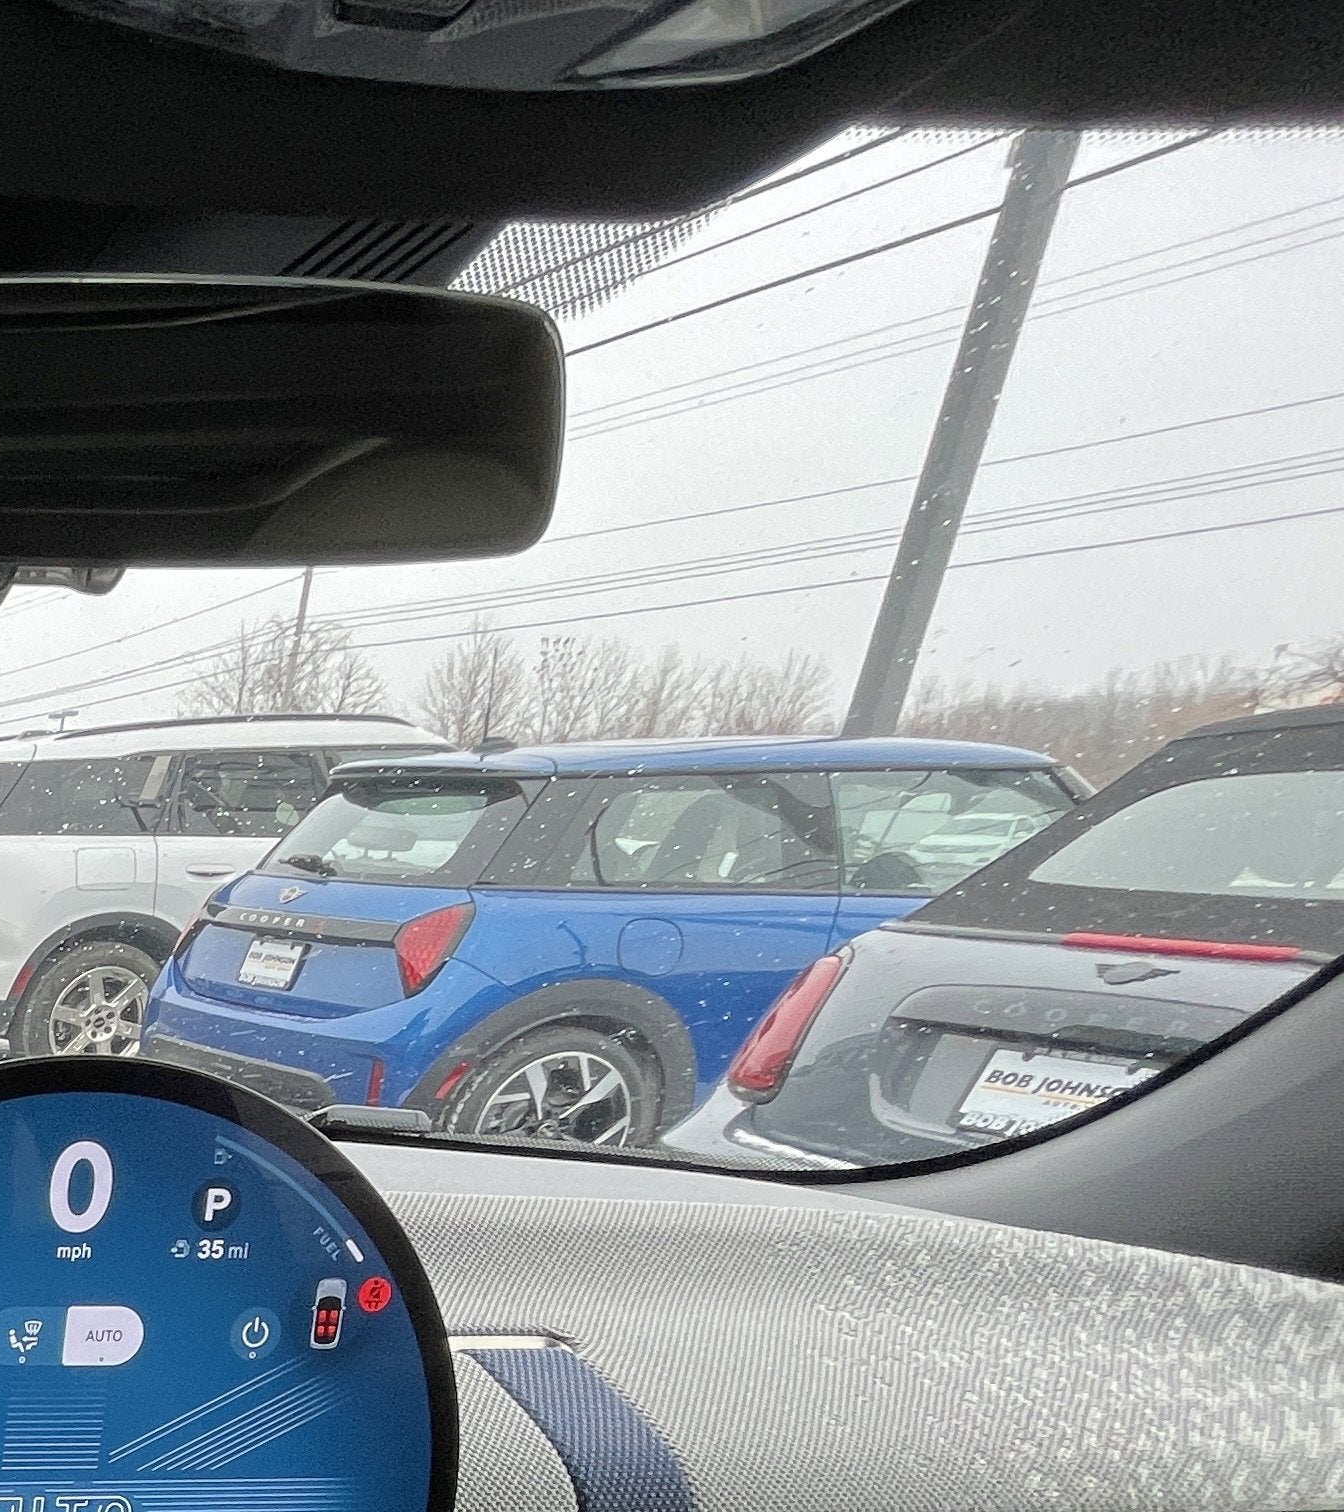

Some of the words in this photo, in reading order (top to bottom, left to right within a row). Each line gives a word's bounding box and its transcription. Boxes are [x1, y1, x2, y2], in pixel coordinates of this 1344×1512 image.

[238, 912, 306, 928] COOPER
[984, 1069, 1034, 1089] BOB
[1032, 1076, 1130, 1099] JOHNSO
[49, 1140, 113, 1234] 0
[204, 1187, 233, 1222] P
[56, 1242, 93, 1262] mph
[196, 1238, 225, 1260] 35
[227, 1241, 250, 1260] mi
[312, 1226, 341, 1262] FUEL
[85, 1329, 124, 1343] AUTO
